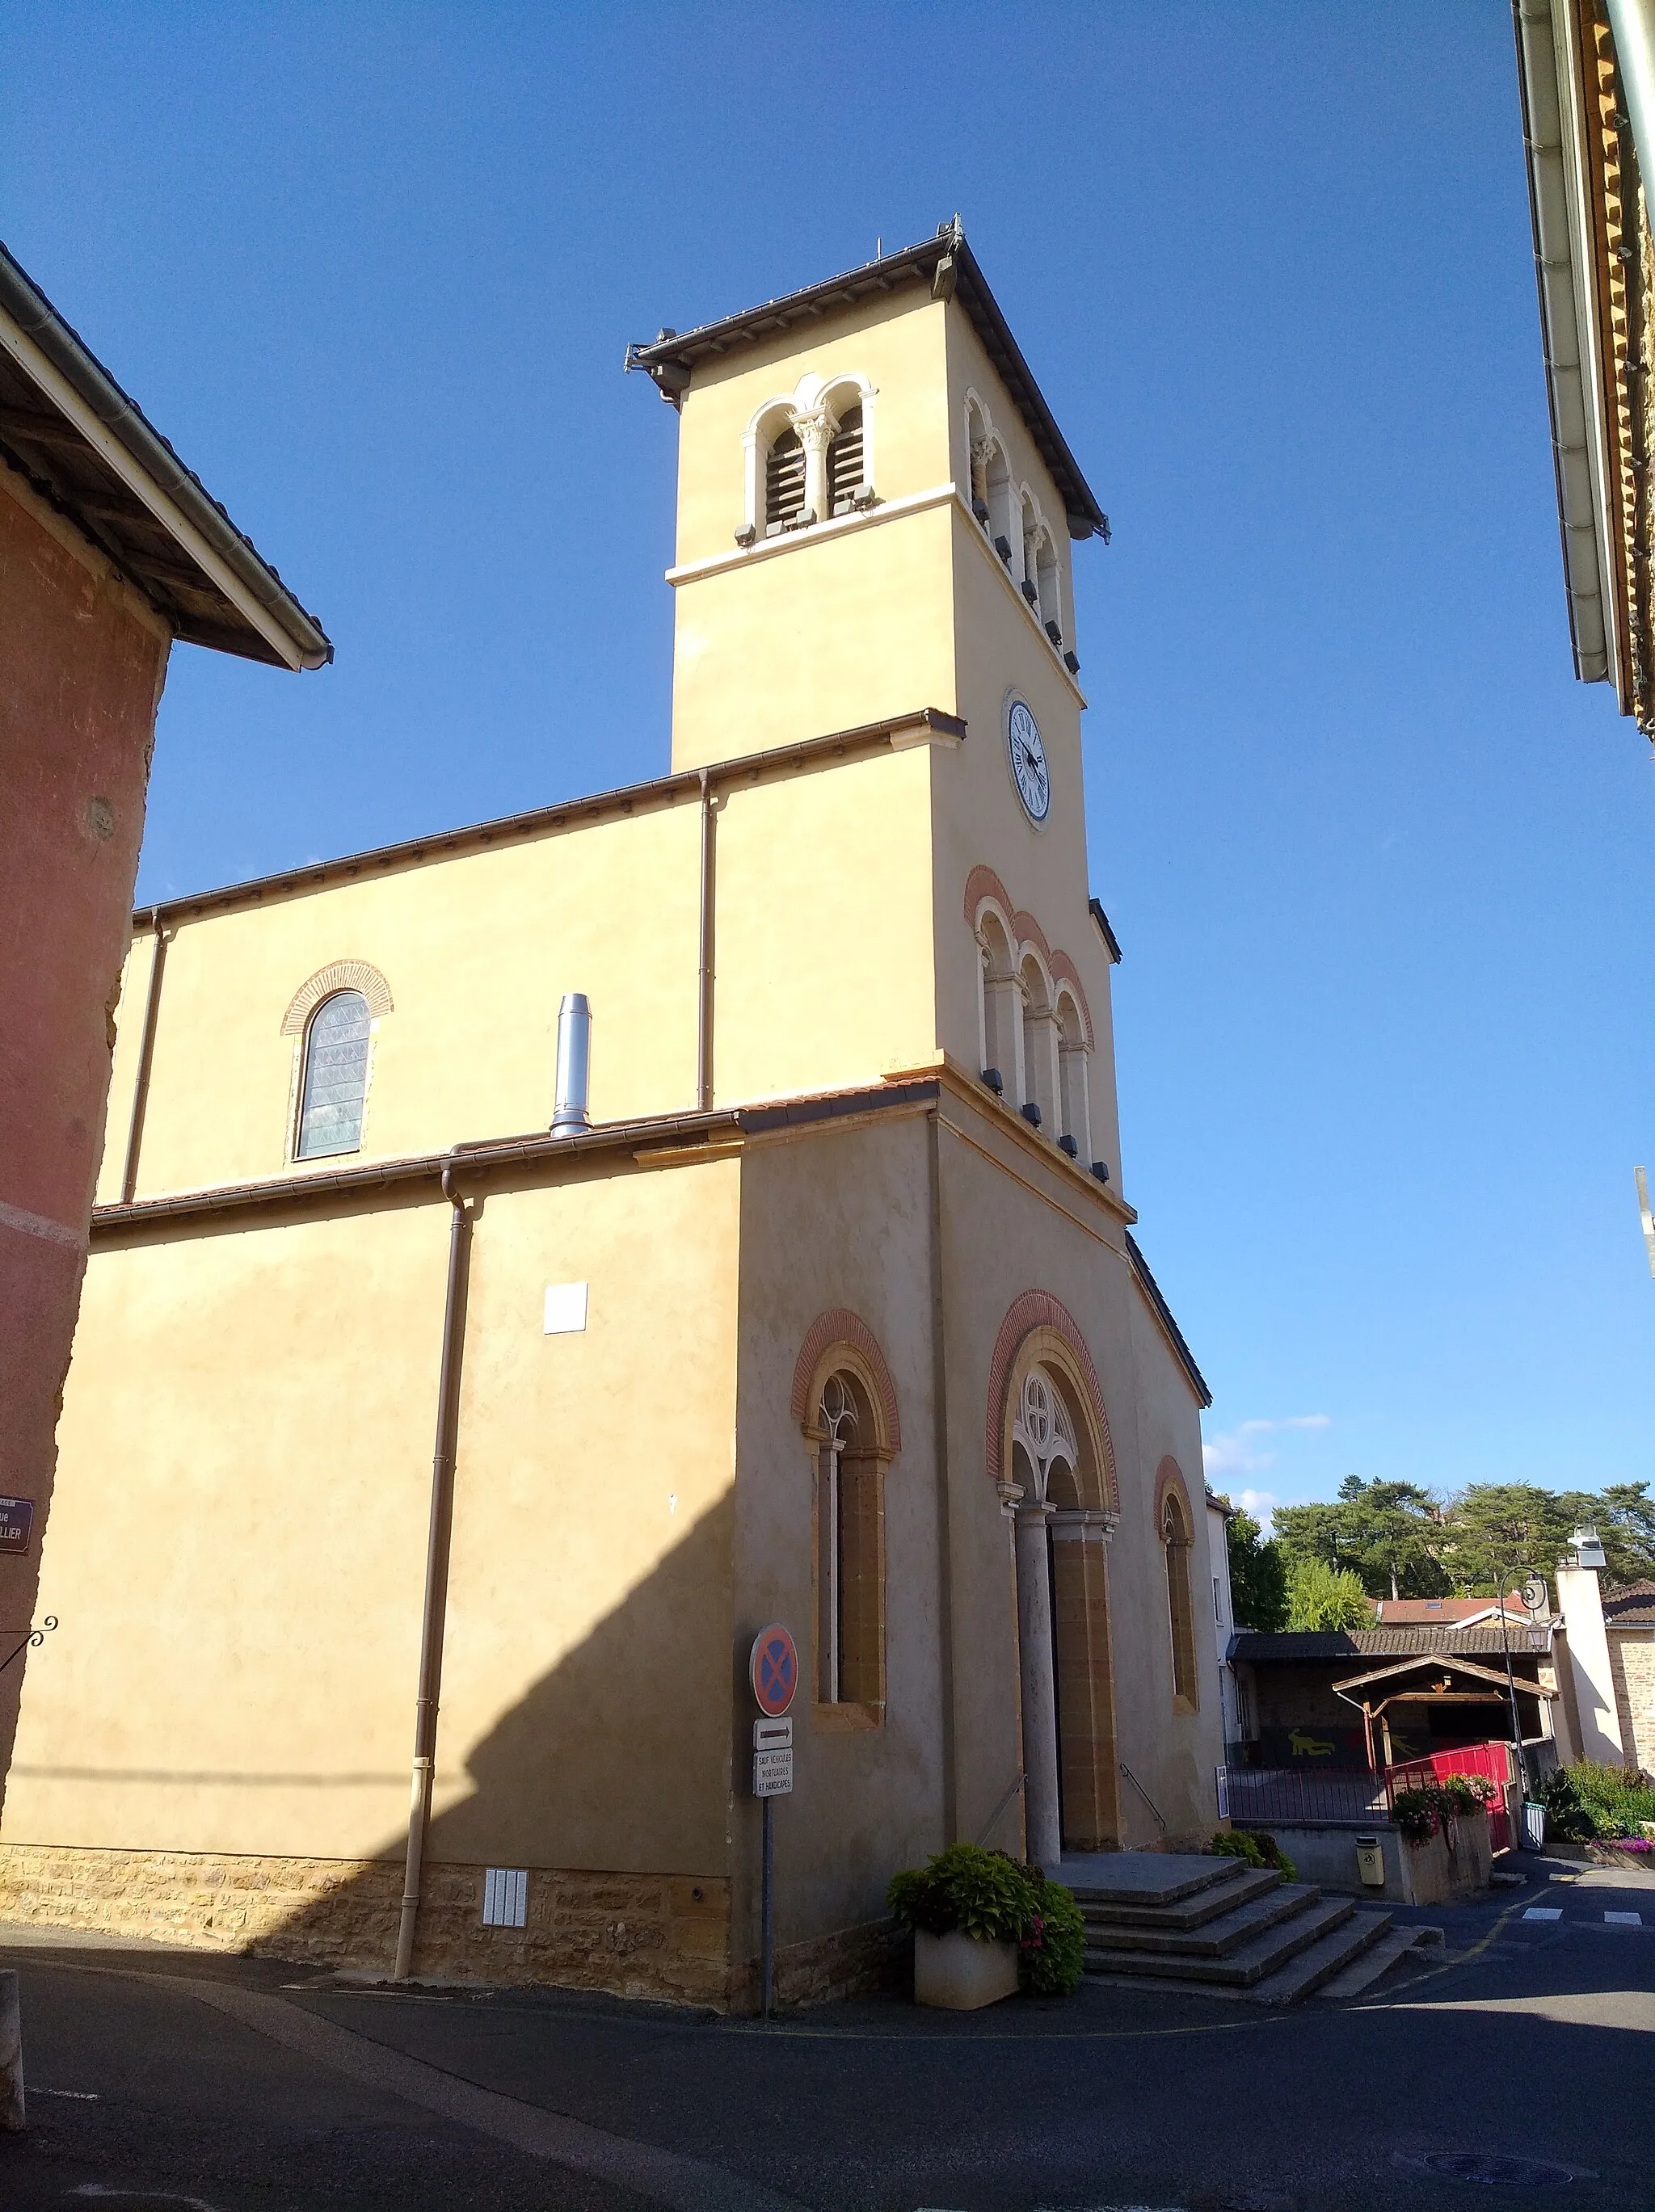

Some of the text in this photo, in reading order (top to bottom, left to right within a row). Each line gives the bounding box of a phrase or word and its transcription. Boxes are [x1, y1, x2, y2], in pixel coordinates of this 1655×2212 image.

[758, 1756, 769, 1765] SAUF
[762, 1767, 789, 1777] MORTUAIRES
[759, 1782, 764, 1792] ET
